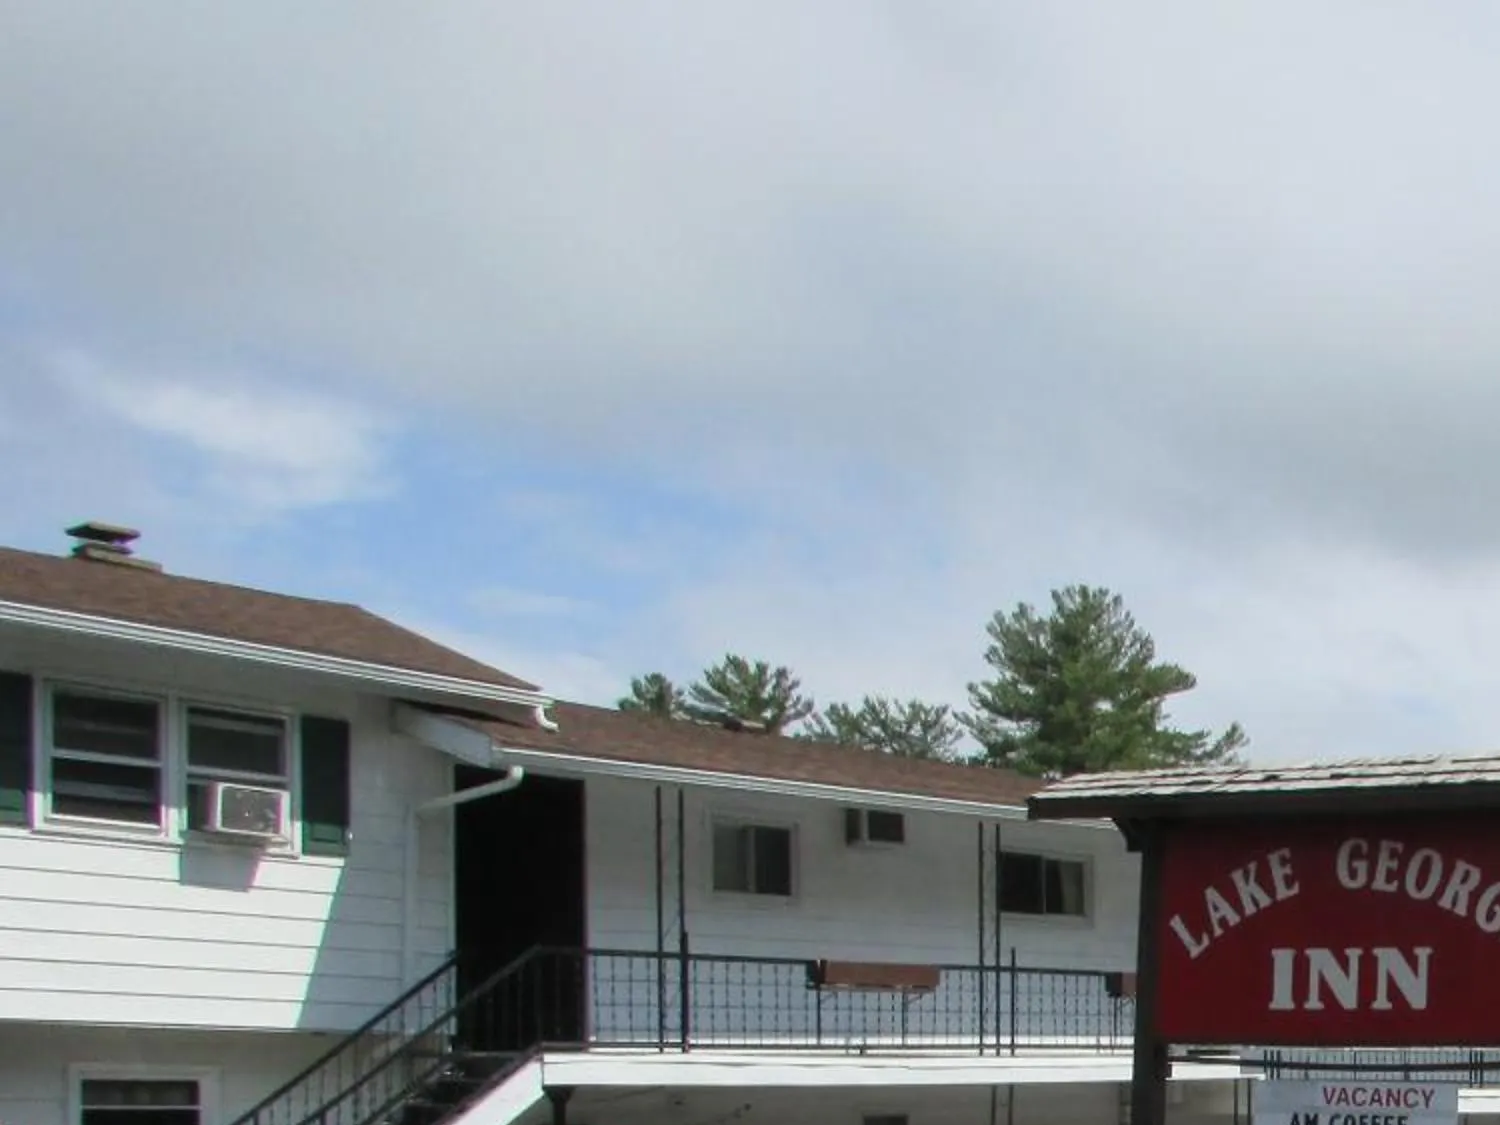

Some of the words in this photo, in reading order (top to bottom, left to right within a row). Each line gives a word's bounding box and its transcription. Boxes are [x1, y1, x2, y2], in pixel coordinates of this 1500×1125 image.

[1169, 847, 1301, 959] LAKE
[1267, 946, 1434, 1011] INN
[1322, 1086, 1435, 1109] VACANCY
